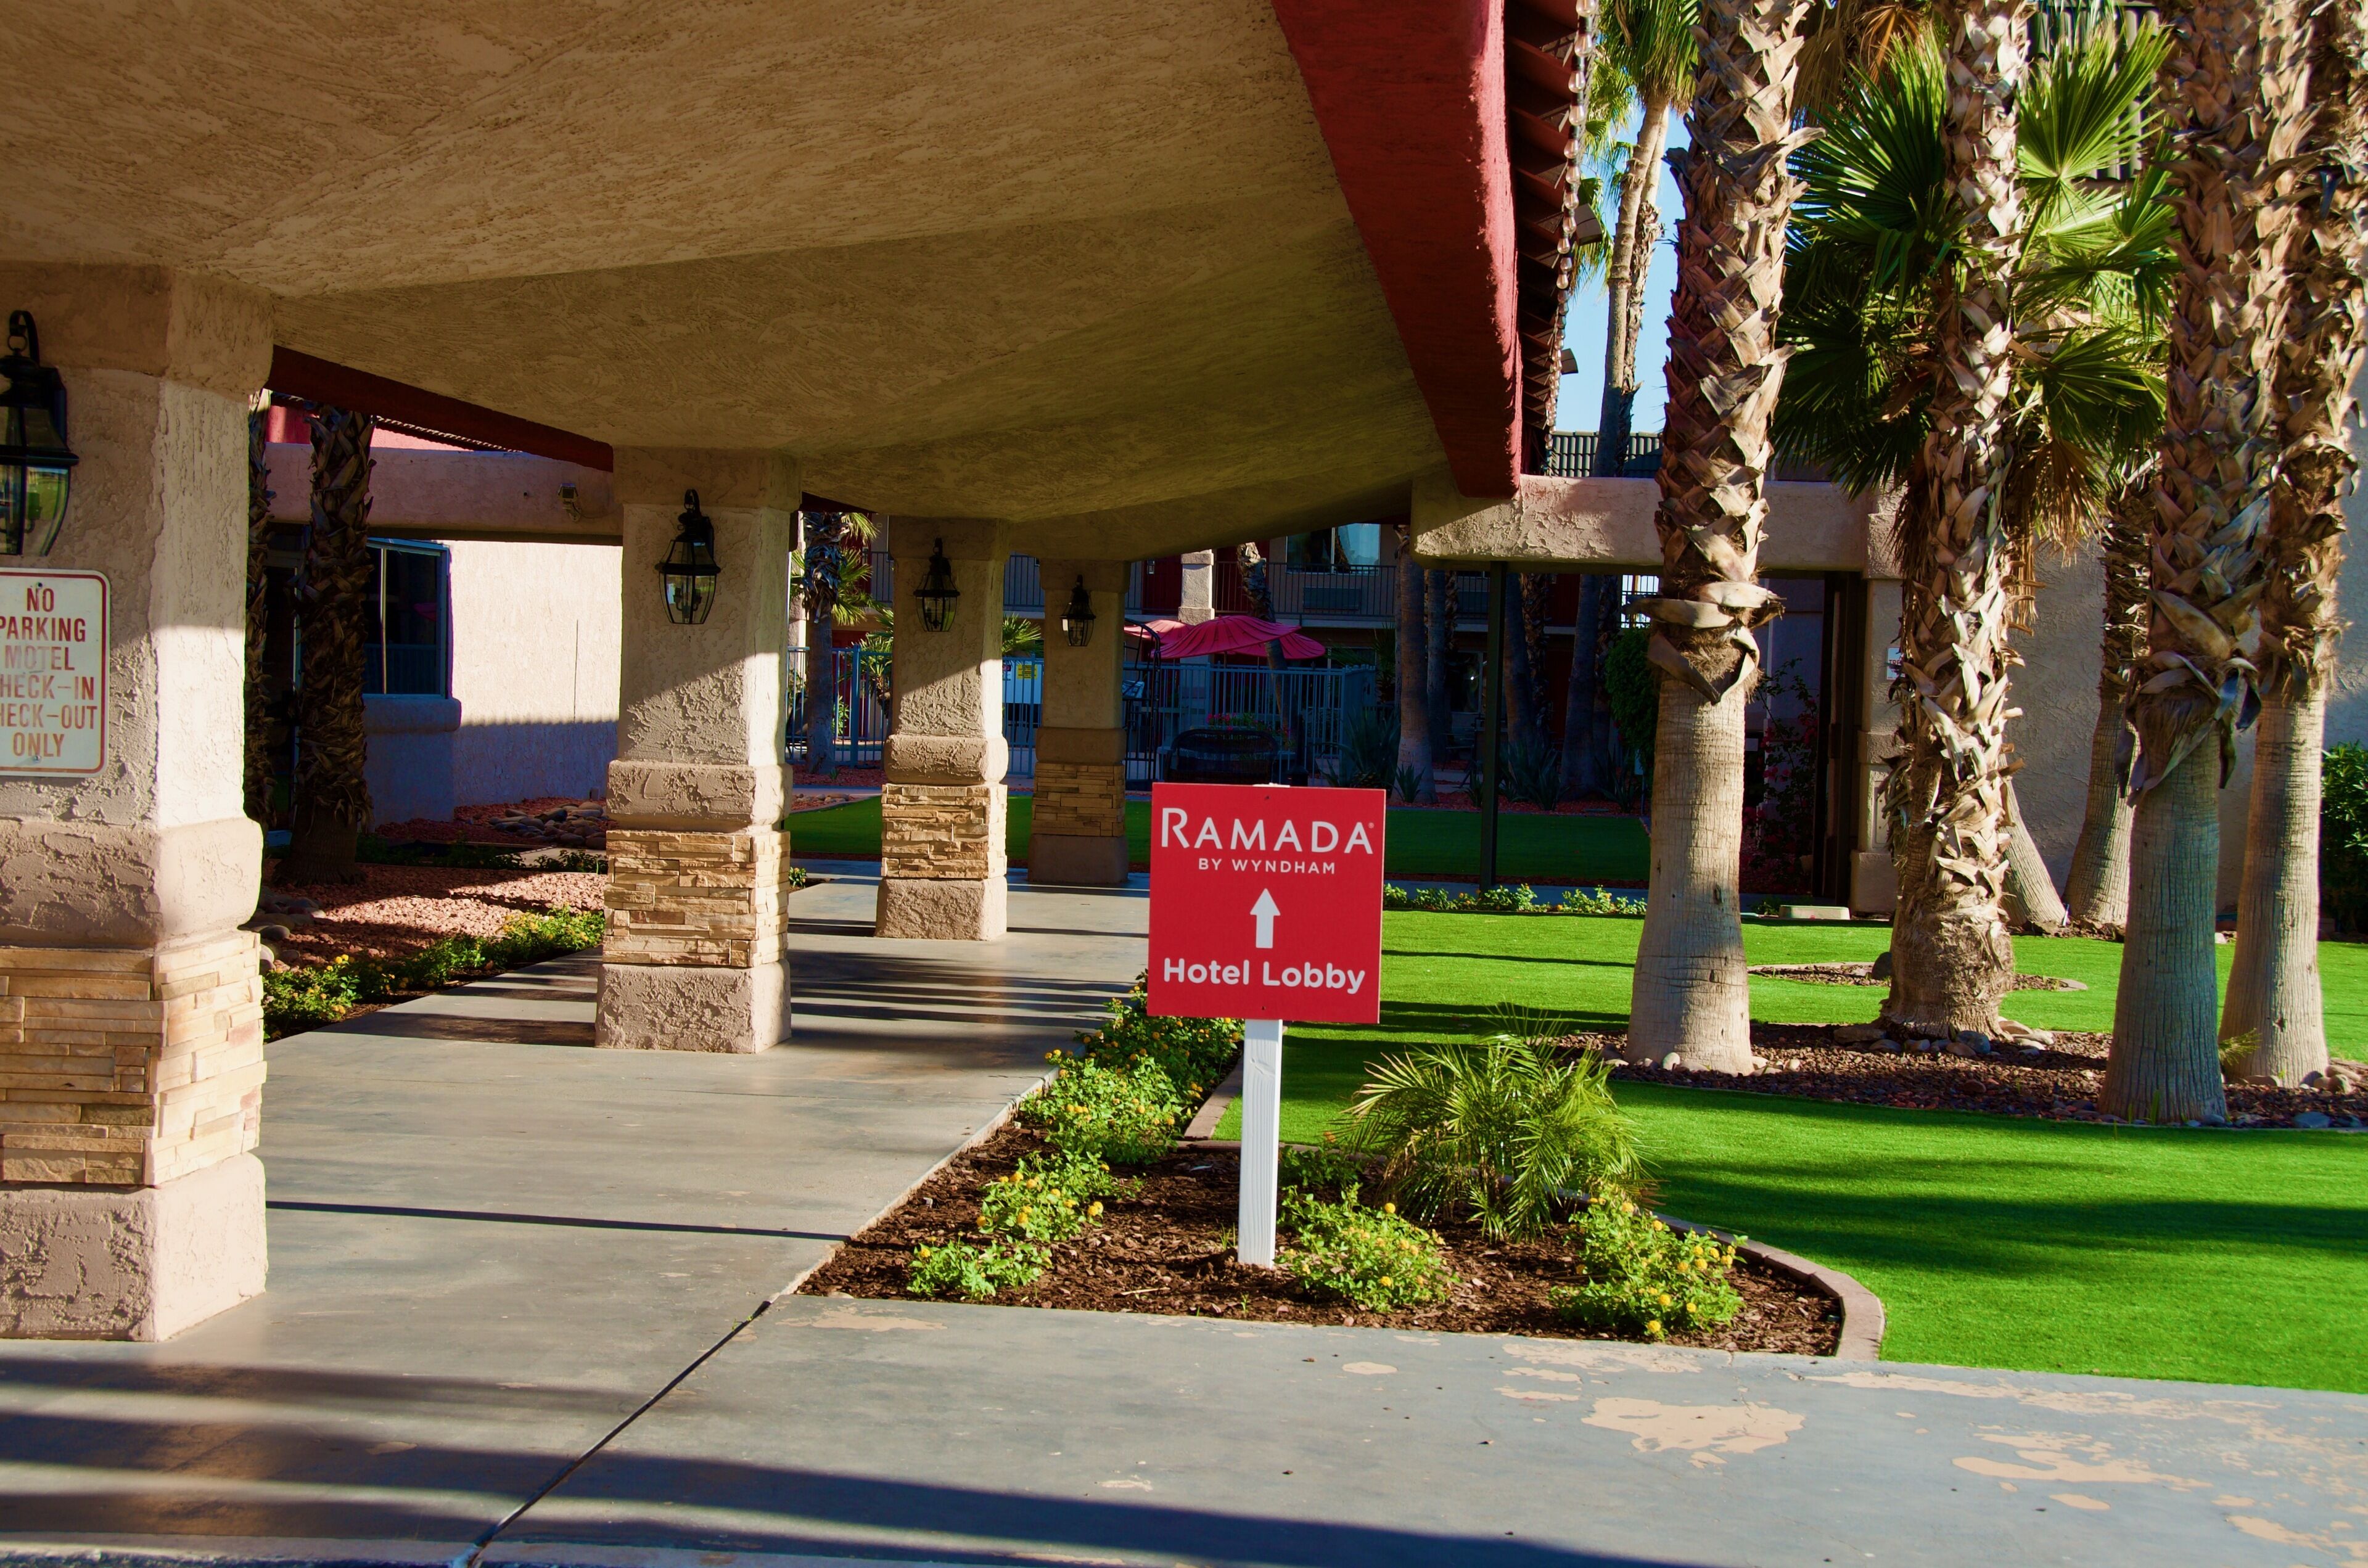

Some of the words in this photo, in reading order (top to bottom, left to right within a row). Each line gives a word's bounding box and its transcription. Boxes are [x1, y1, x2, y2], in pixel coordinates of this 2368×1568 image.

[27, 588, 54, 612] NO
[5, 645, 75, 671] MOTEL
[13, 732, 65, 757] ONLY
[1198, 858, 1222, 871] BY
[1231, 859, 1336, 874] WYNDHAM
[1164, 958, 1250, 985] Hotel
[1263, 961, 1365, 995] Lobby
